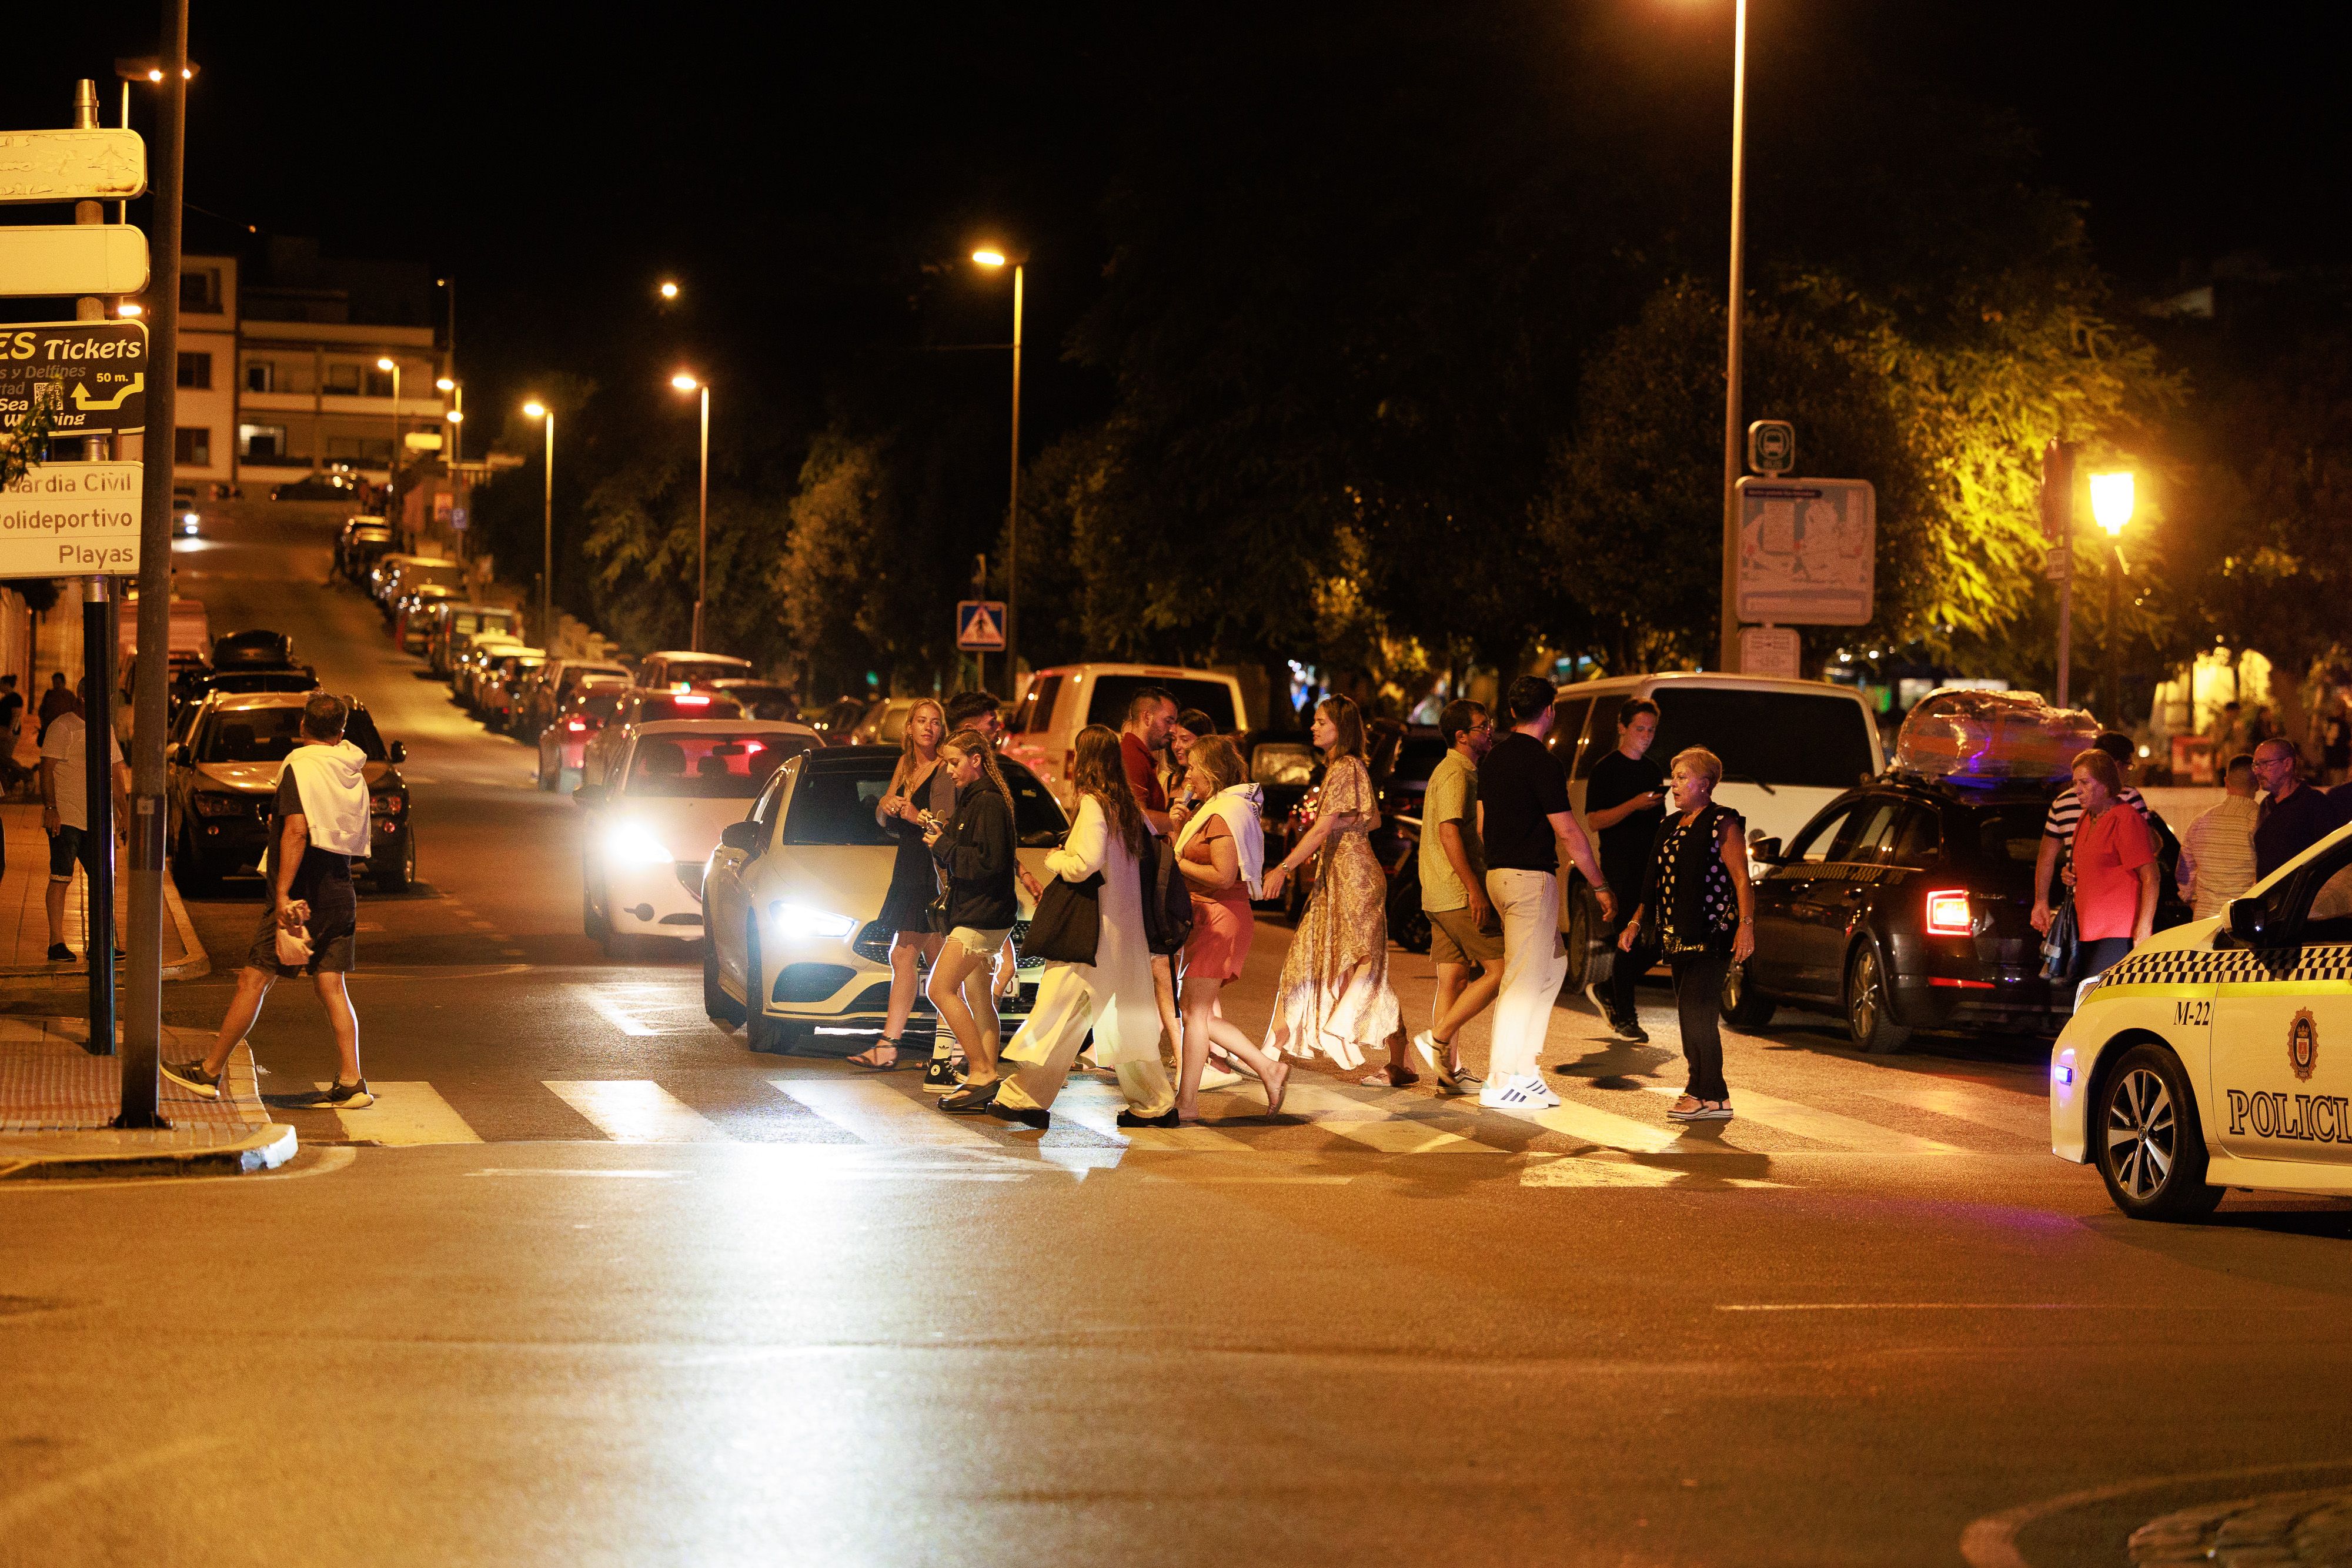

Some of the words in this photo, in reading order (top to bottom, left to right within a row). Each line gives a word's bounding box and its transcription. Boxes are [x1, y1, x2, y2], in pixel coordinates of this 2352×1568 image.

[44, 338, 142, 360] Tickets
[25, 365, 86, 379] Delfines
[96, 373, 111, 383] 50
[114, 374, 129, 382] m.
[0, 398, 29, 411] Sea
[84, 473, 131, 492] Civil
[0, 508, 132, 534] olideportivo
[59, 544, 134, 569] Playas
[2173, 1001, 2210, 1025] M-22
[2227, 1089, 2352, 1144] POLICI
